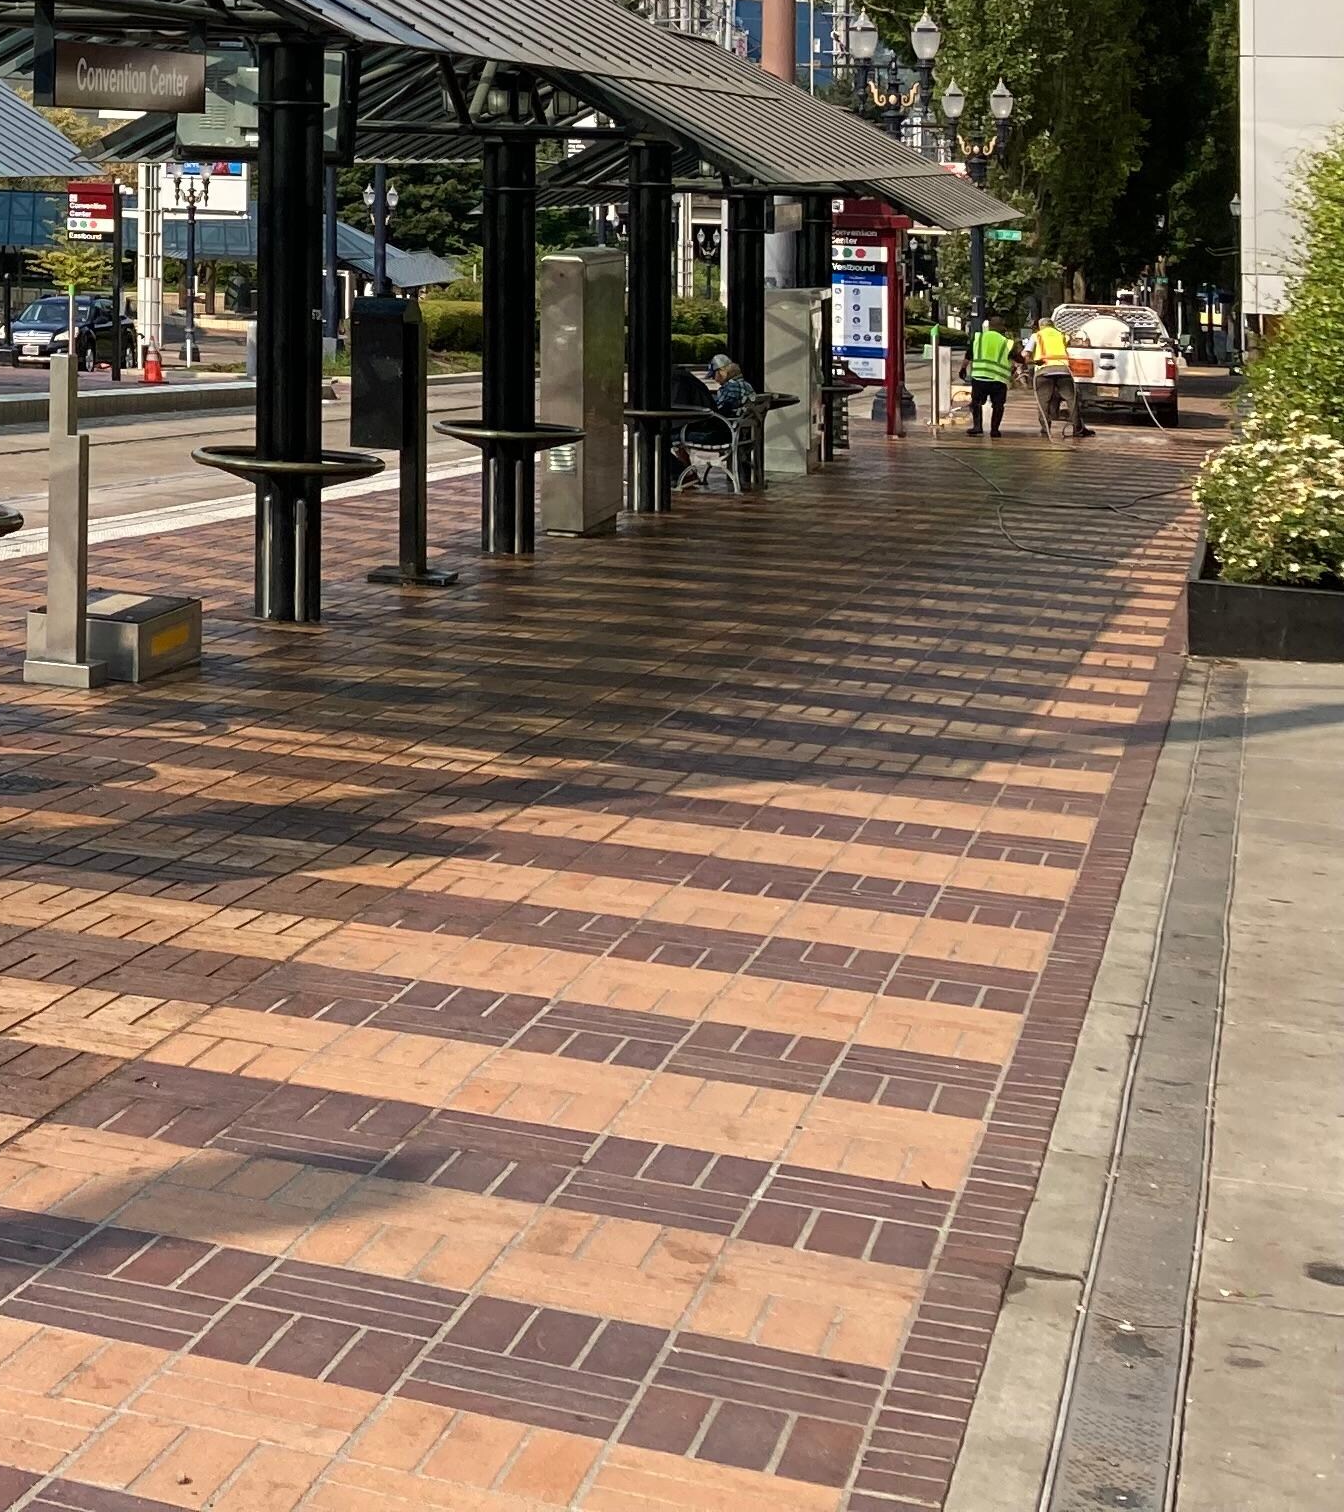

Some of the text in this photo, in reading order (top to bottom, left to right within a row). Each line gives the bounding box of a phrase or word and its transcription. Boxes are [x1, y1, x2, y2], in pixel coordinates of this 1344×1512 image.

[76, 57, 189, 97] Convention Center
[68, 232, 102, 240] Eastbound
